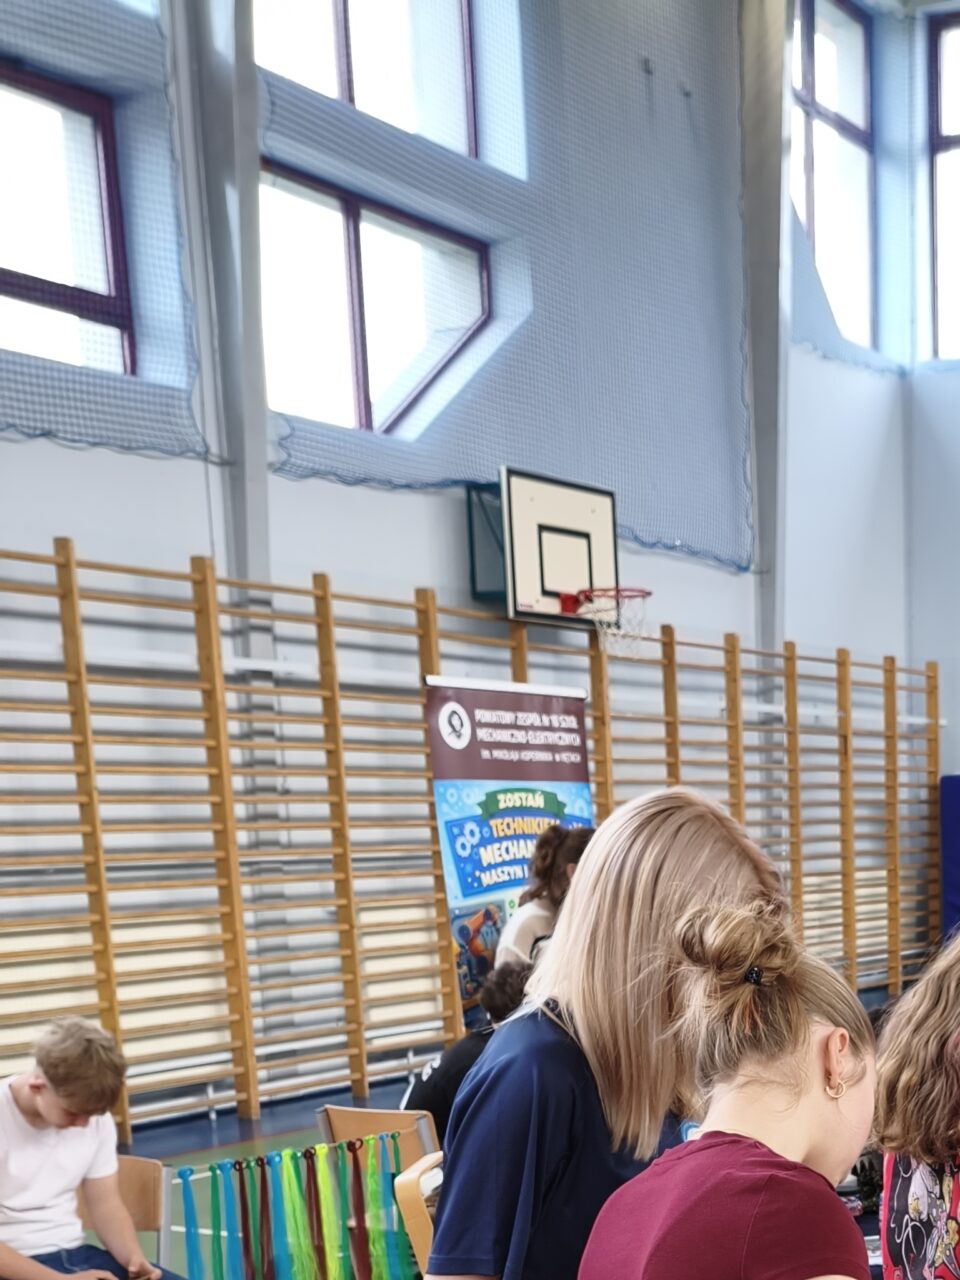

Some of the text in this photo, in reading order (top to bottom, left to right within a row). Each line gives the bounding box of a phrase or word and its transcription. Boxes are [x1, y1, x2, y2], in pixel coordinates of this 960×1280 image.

[497, 791, 545, 809] ZOSTAŃ
[489, 816, 560, 838] TECHNIKIE
[480, 839, 537, 867] MECHAN
[480, 865, 522, 887] MASZYN
